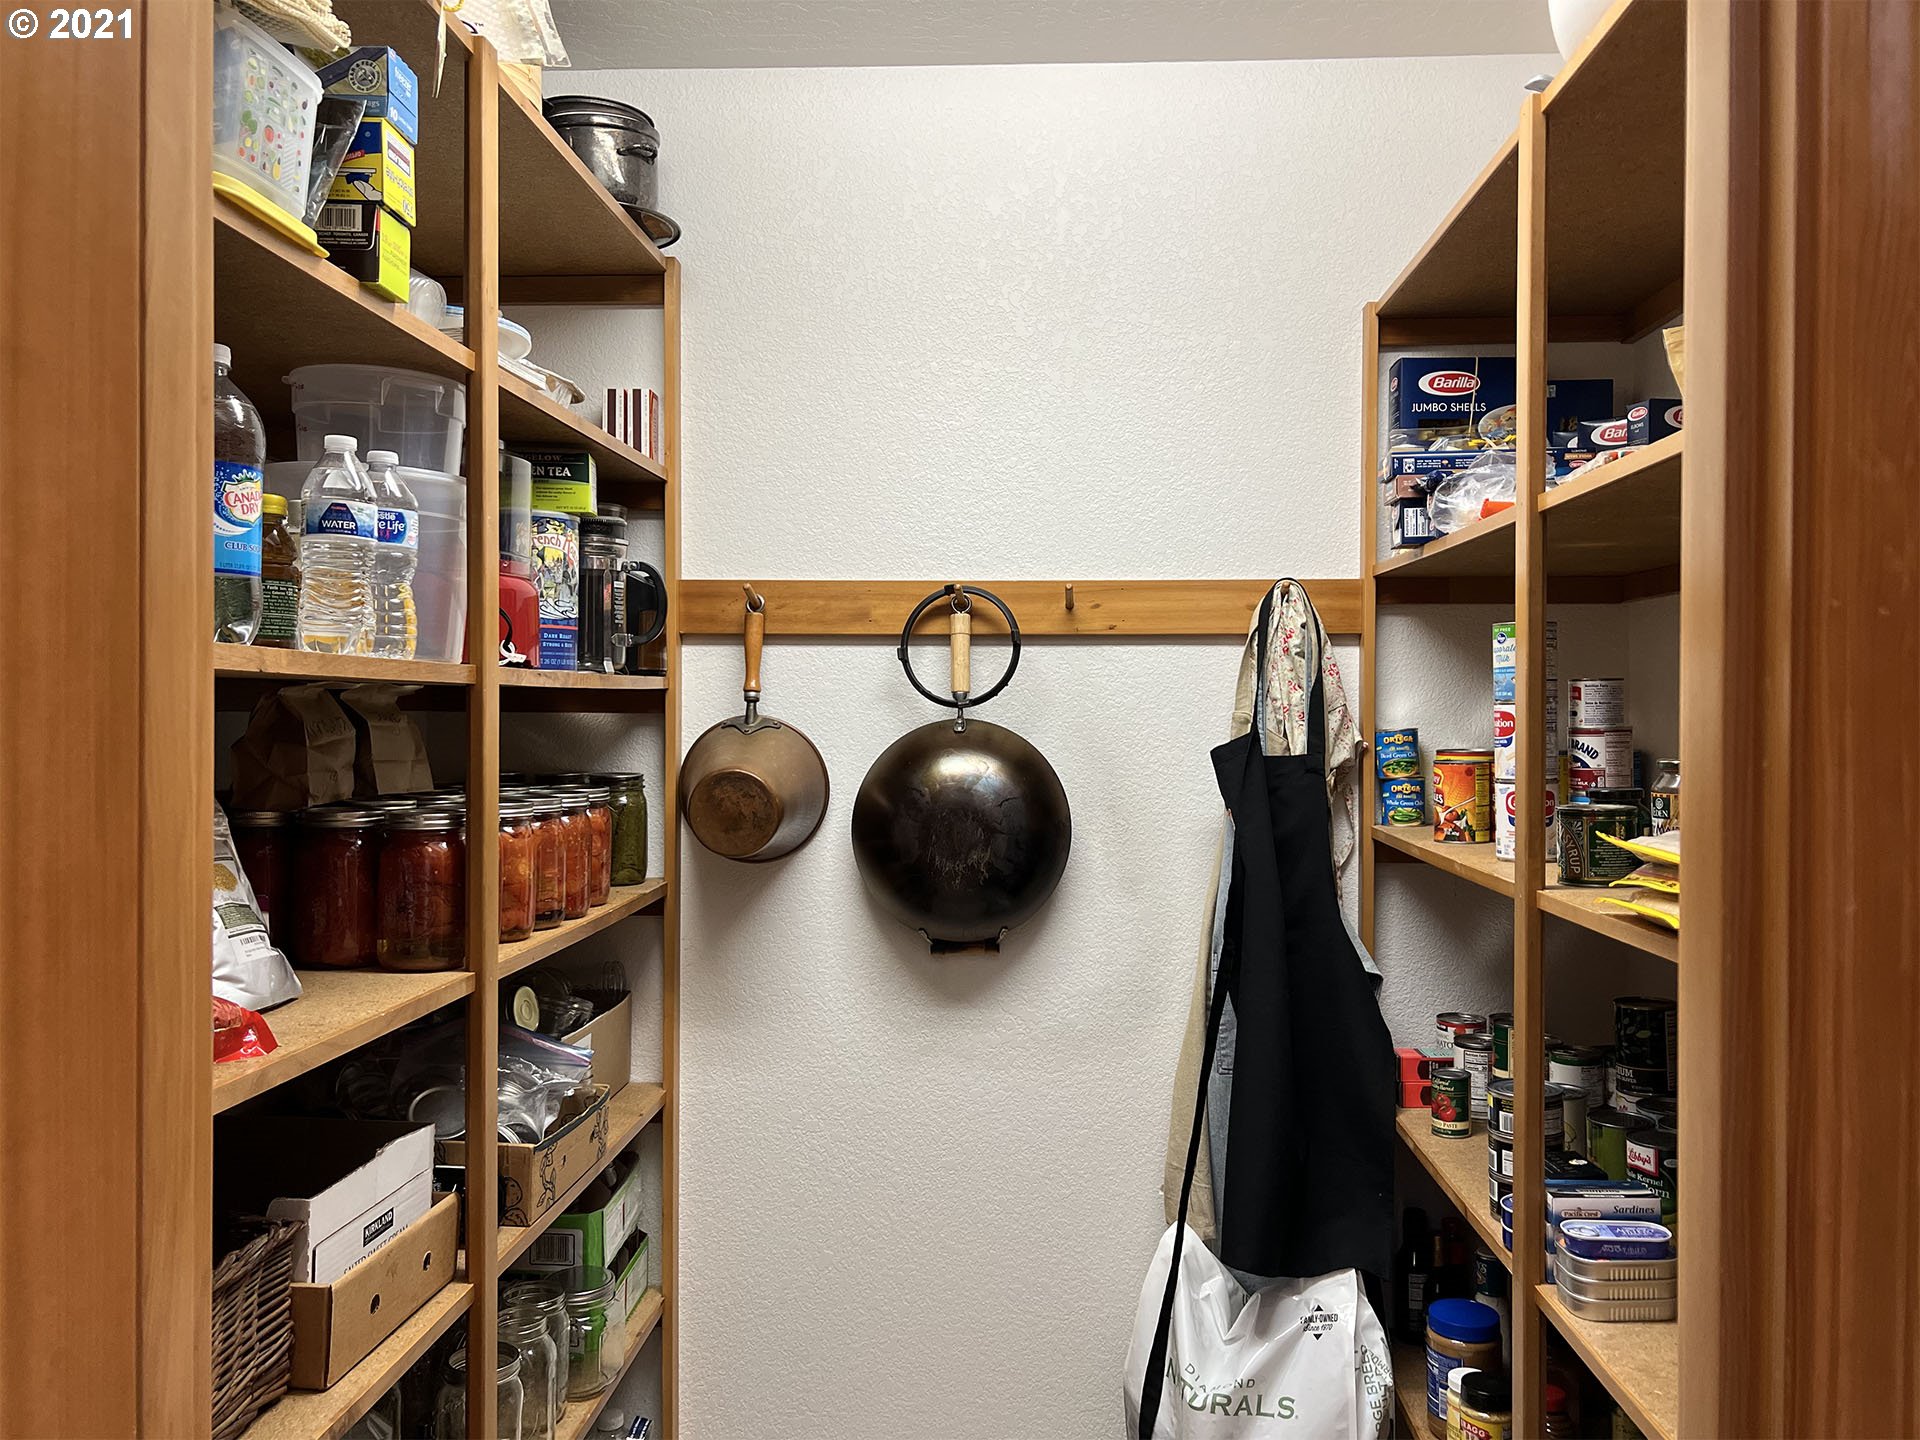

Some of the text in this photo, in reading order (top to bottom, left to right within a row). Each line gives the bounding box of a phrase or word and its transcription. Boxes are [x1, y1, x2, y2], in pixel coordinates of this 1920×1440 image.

[1433, 376, 1475, 389] Barilla
[1412, 402, 1487, 412] JUMBO SHELLS
[1604, 426, 1628, 439] Bar
[548, 467, 572, 477] TEA
[224, 491, 262, 508] CANAD
[241, 502, 259, 515] DRY
[321, 519, 356, 530] WATER
[387, 521, 405, 535] Life
[225, 541, 248, 551] CLUB
[532, 534, 561, 548] rench
[1383, 733, 1414, 745] ORTEGA
[1391, 782, 1421, 794] ORTEGA
[1564, 834, 1581, 874] SYRUP
[1637, 1173, 1664, 1187] Kernel
[1613, 1205, 1656, 1214] Sardines
[364, 1211, 393, 1239] KIRKLAND
